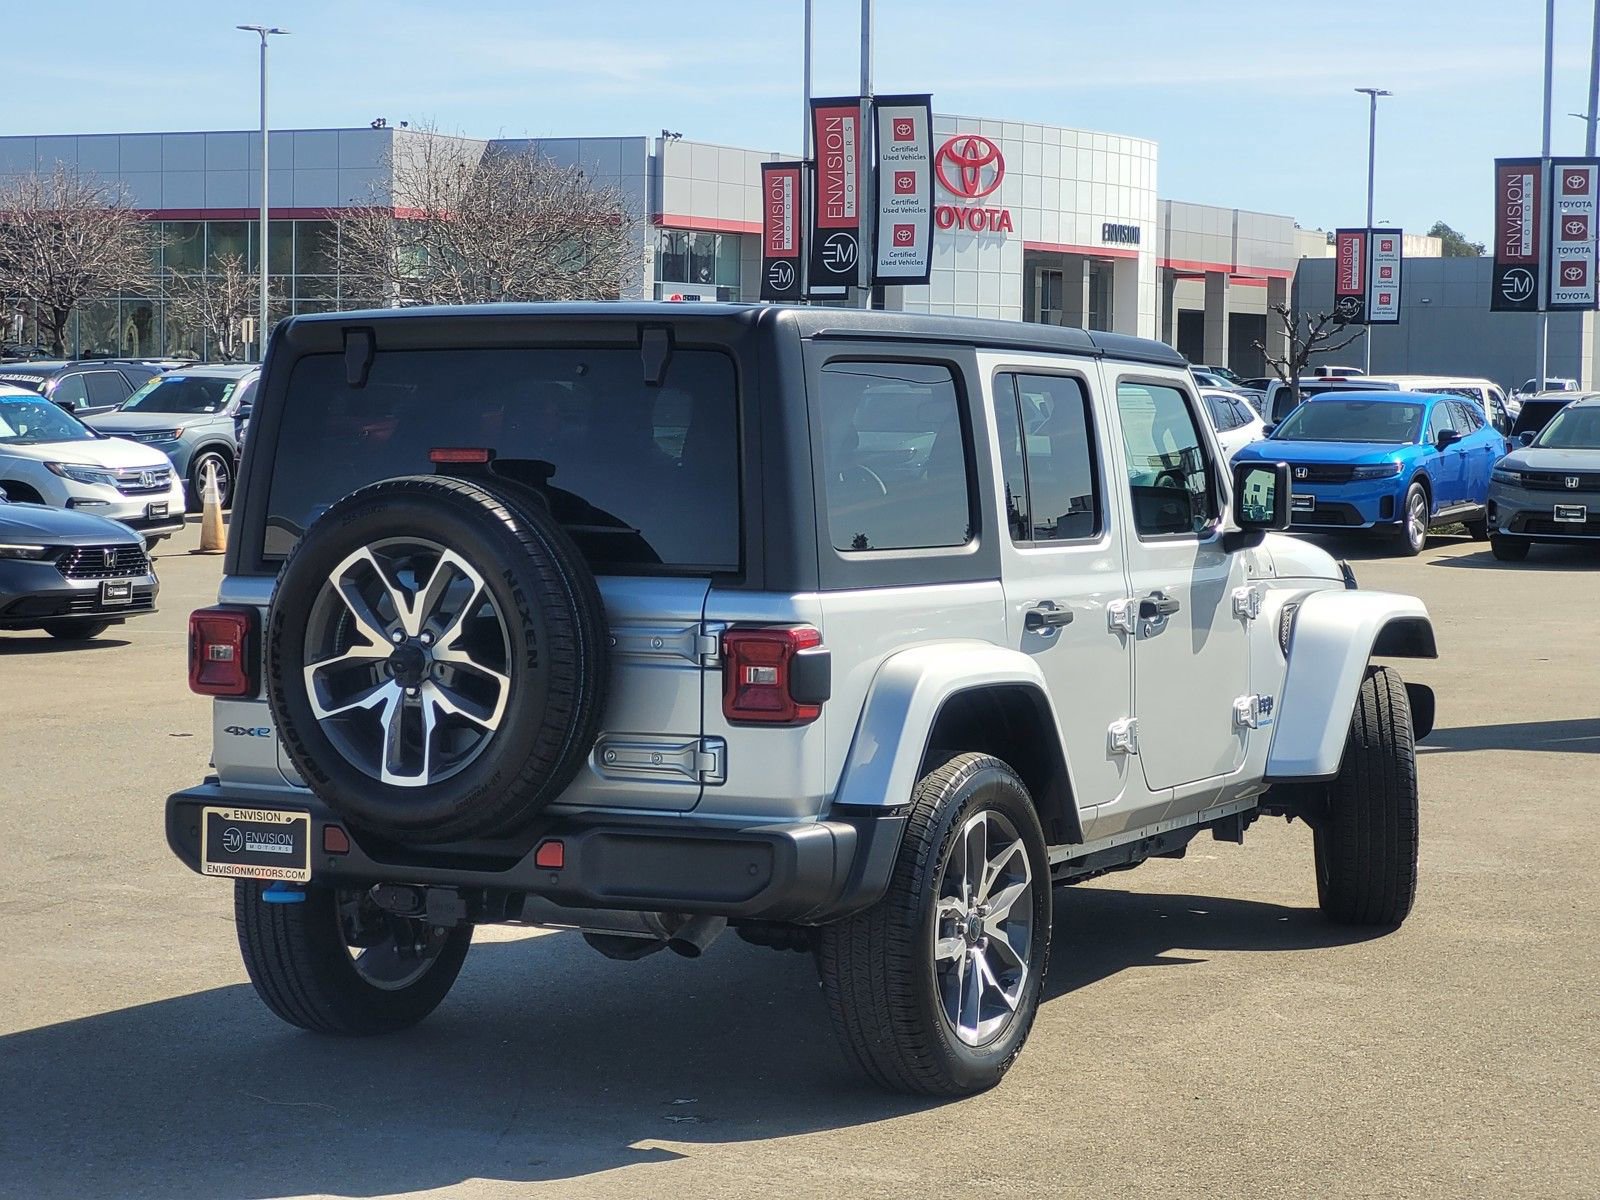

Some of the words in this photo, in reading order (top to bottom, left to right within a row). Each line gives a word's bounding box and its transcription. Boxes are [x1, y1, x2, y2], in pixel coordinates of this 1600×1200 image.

[882, 153, 897, 161] Used
[898, 153, 927, 161] Vehicles
[890, 145, 919, 153] Certified
[825, 116, 843, 219] ENVISION
[845, 126, 855, 210] MOTORS
[771, 175, 784, 251] ENVISION
[784, 182, 792, 244] MOTORS
[882, 206, 897, 214] Used
[898, 206, 927, 214] Vehicles
[934, 205, 1014, 233] OYOTA
[1506, 174, 1522, 256] ENVISION
[1524, 181, 1532, 250] MOTORS
[1102, 222, 1141, 245] ENVISION
[896, 258, 924, 266] Vehicles
[1342, 237, 1353, 290] ENVISION
[1555, 292, 1590, 300] TOYOTA
[503, 568, 538, 670] NEXEN
[233, 809, 281, 822] ENVISION
[245, 831, 294, 845] ENVISION
[249, 844, 290, 852] MOTORS
[206, 864, 306, 880] ENVISIONMOTORS.COM
